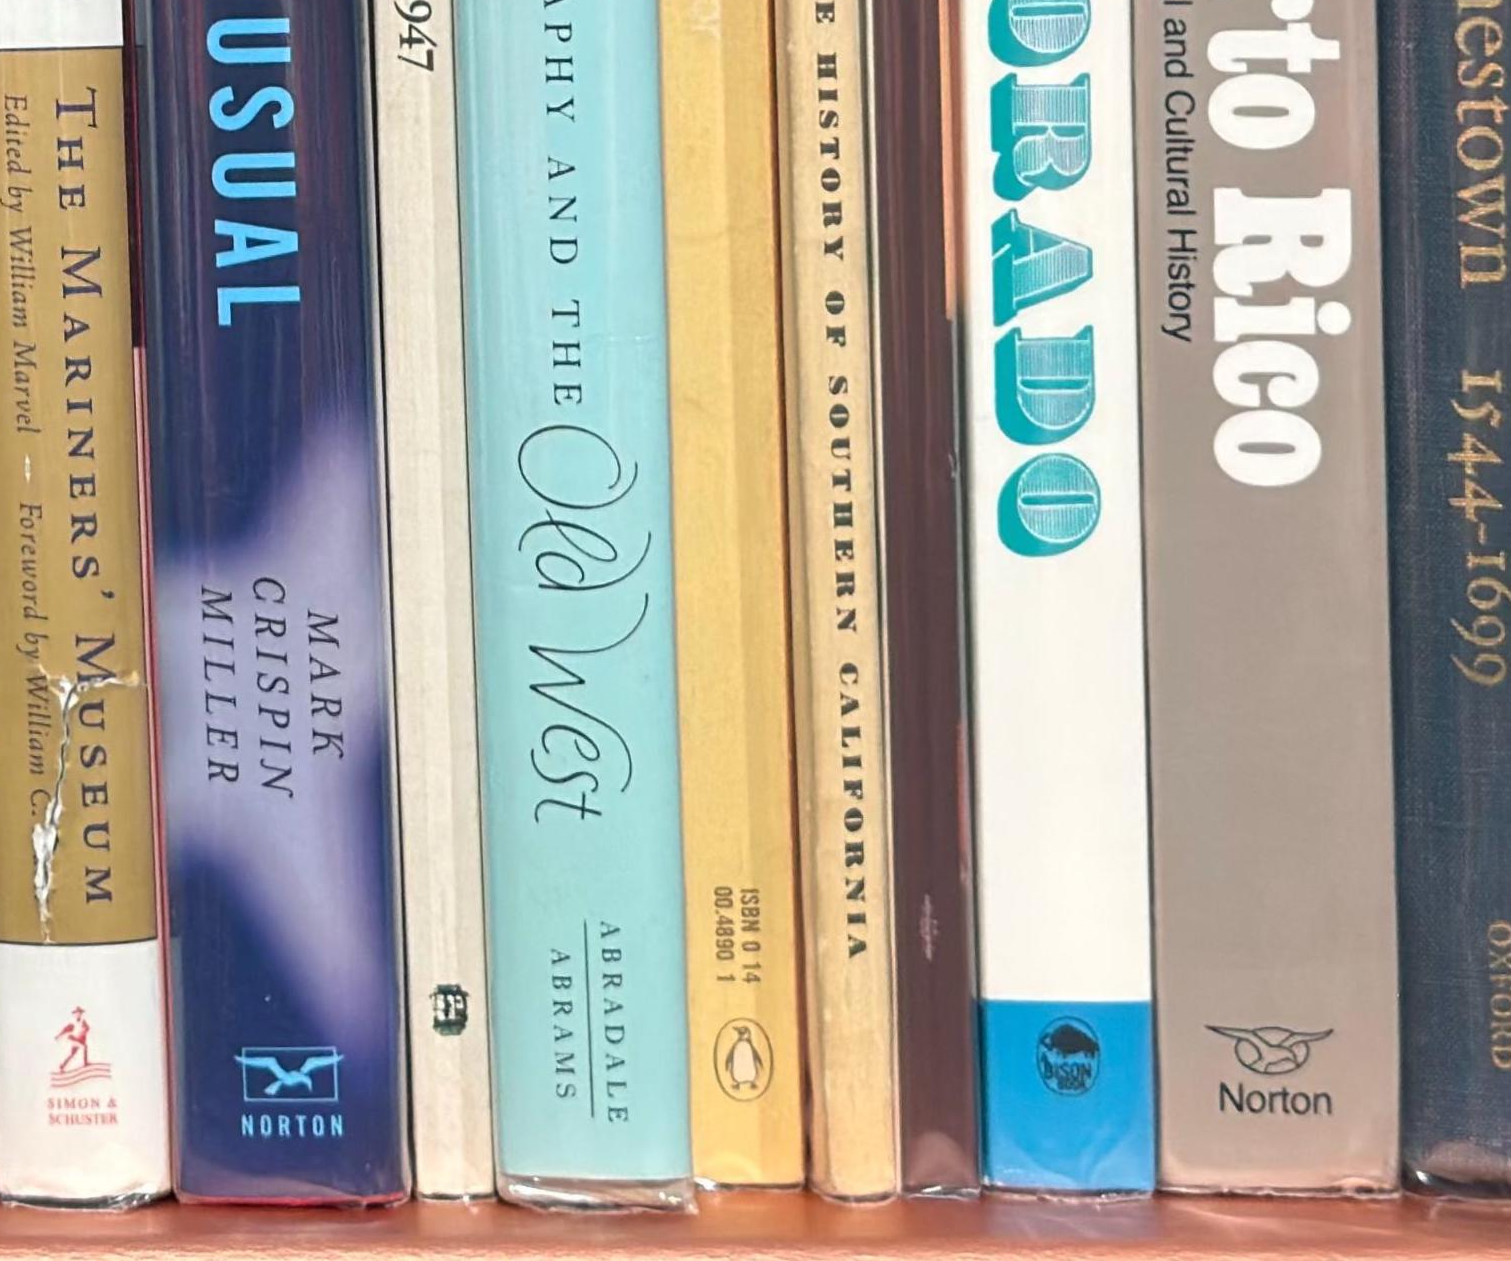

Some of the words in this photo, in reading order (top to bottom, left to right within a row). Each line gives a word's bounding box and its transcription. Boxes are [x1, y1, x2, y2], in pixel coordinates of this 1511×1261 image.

[1162, 17, 1196, 81] and
[4, 93, 33, 177] Edited
[55, 85, 99, 211] THE
[816, 52, 845, 262] HISTORY
[1163, 88, 1197, 216] Cultural
[546, 155, 580, 266] AND
[9, 226, 37, 329] William
[824, 290, 847, 348] OF
[1160, 228, 1198, 344] History
[1211, 187, 1353, 488] Rico
[12, 340, 42, 434] Marvel
[551, 297, 583, 407] THE
[827, 374, 858, 634] SOUTHERN
[200, 583, 241, 786] MILLER
[251, 575, 294, 800] CRISPIN
[306, 608, 345, 761] MARK
[74, 633, 117, 905] MUSEUM
[837, 661, 868, 960] CALIFORNIA
[550, 947, 578, 1099] ABRAMS
[599, 920, 630, 1124] ABRADALE
[240, 1113, 345, 1139] NORTON
[1217, 1081, 1333, 1116] Norton
